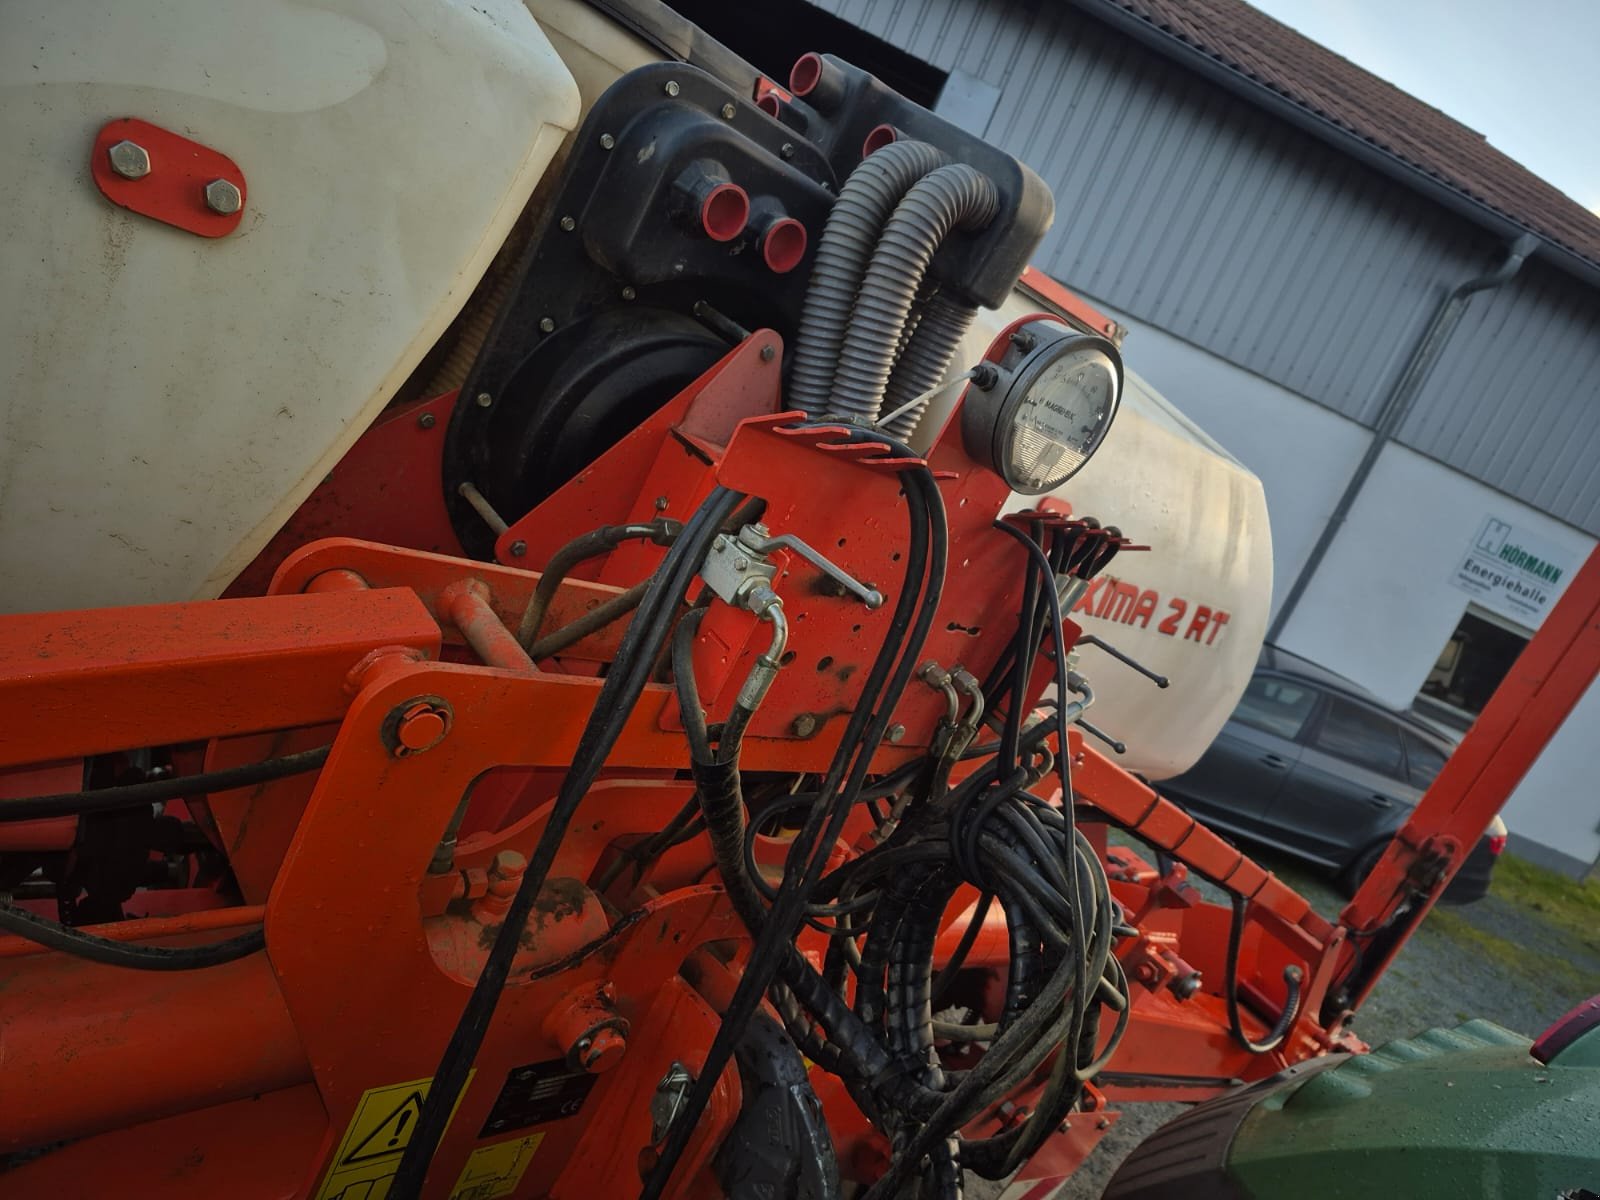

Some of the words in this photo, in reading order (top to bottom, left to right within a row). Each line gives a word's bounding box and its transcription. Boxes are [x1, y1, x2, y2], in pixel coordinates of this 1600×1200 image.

[1463, 558, 1547, 605] Energiehalle
[1499, 543, 1563, 584] HÖRMANN
[1072, 576, 1159, 629] XIMA
[1158, 597, 1188, 636] 2
[1184, 604, 1231, 645] RT
